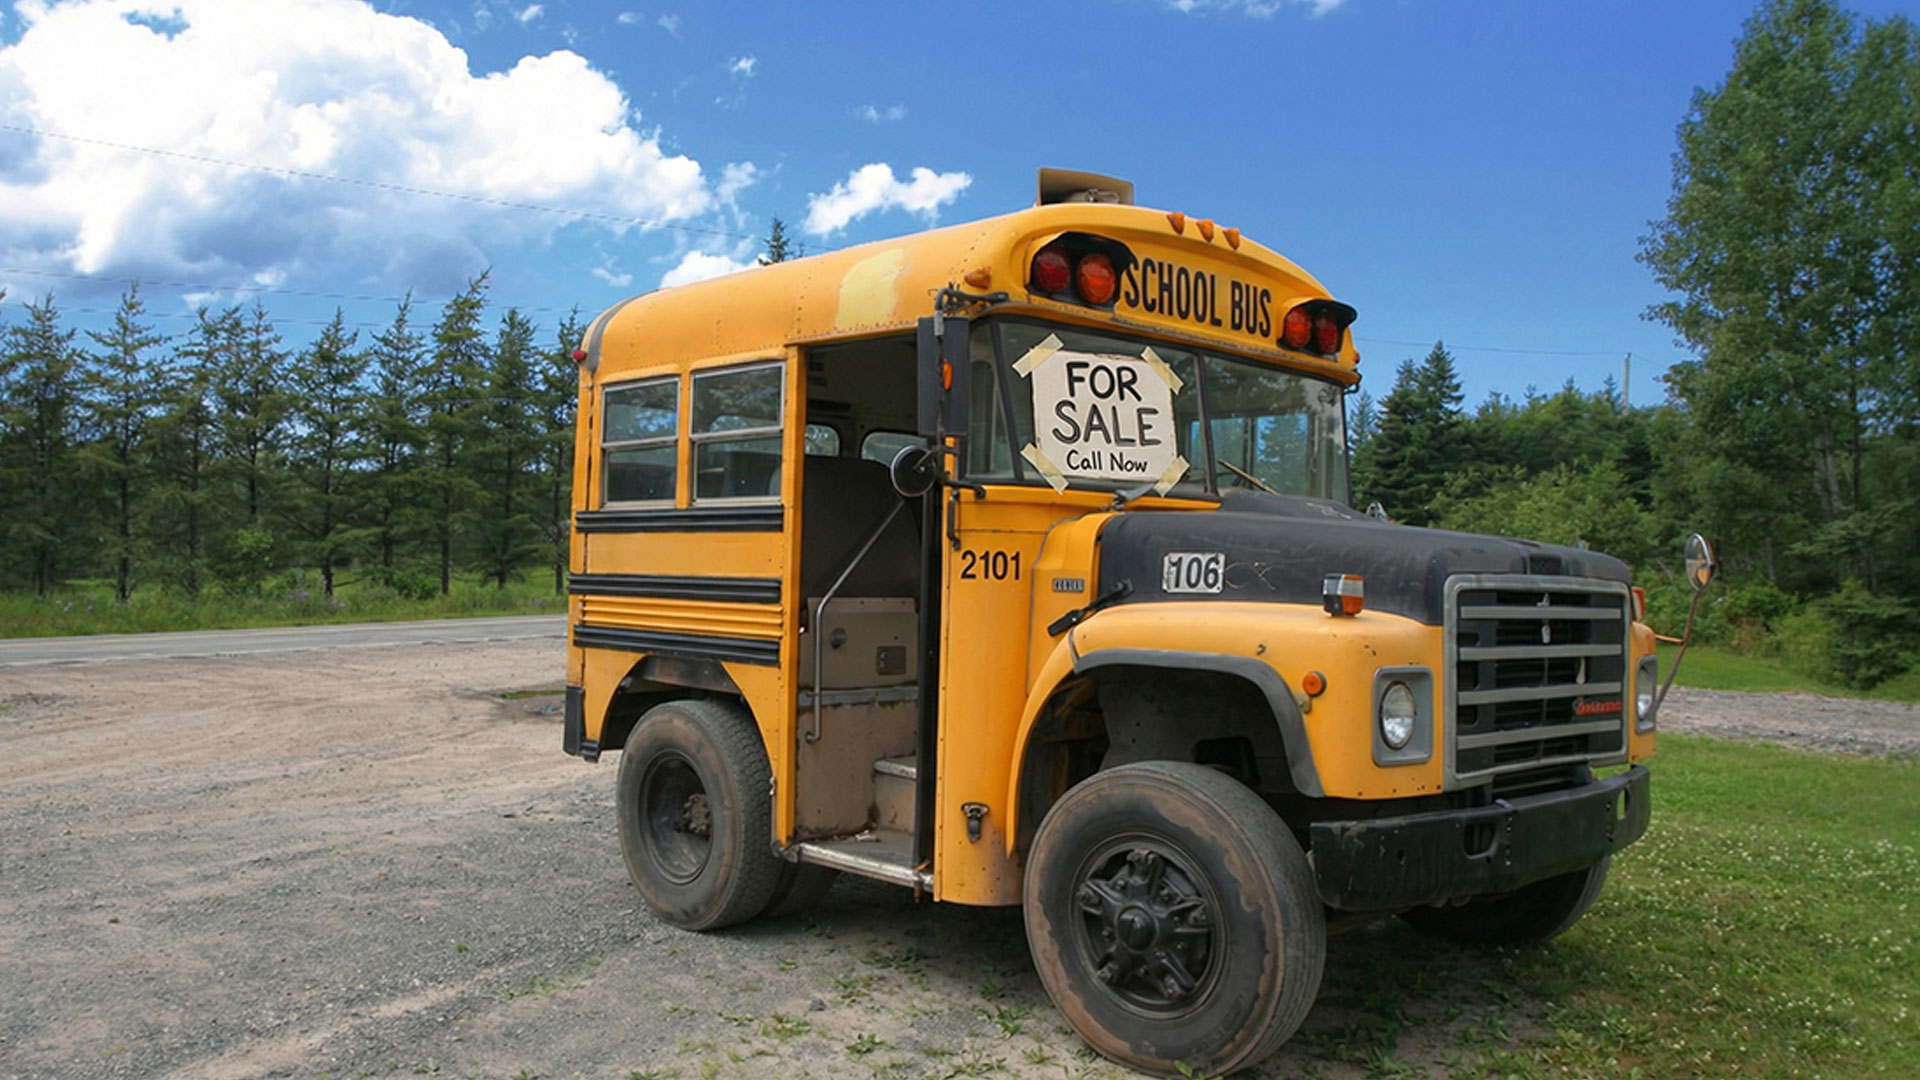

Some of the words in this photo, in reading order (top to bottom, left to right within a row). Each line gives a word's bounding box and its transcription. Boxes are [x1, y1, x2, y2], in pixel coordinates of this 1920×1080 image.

[1124, 257, 1223, 328] SCHOOL
[1231, 280, 1272, 338] BUS
[1066, 361, 1142, 402] FOR
[1052, 399, 1162, 447] SALE
[1066, 449, 1103, 471] Call
[1110, 451, 1148, 472] Now
[961, 549, 1020, 581] 2101
[1169, 556, 1220, 589] 106
